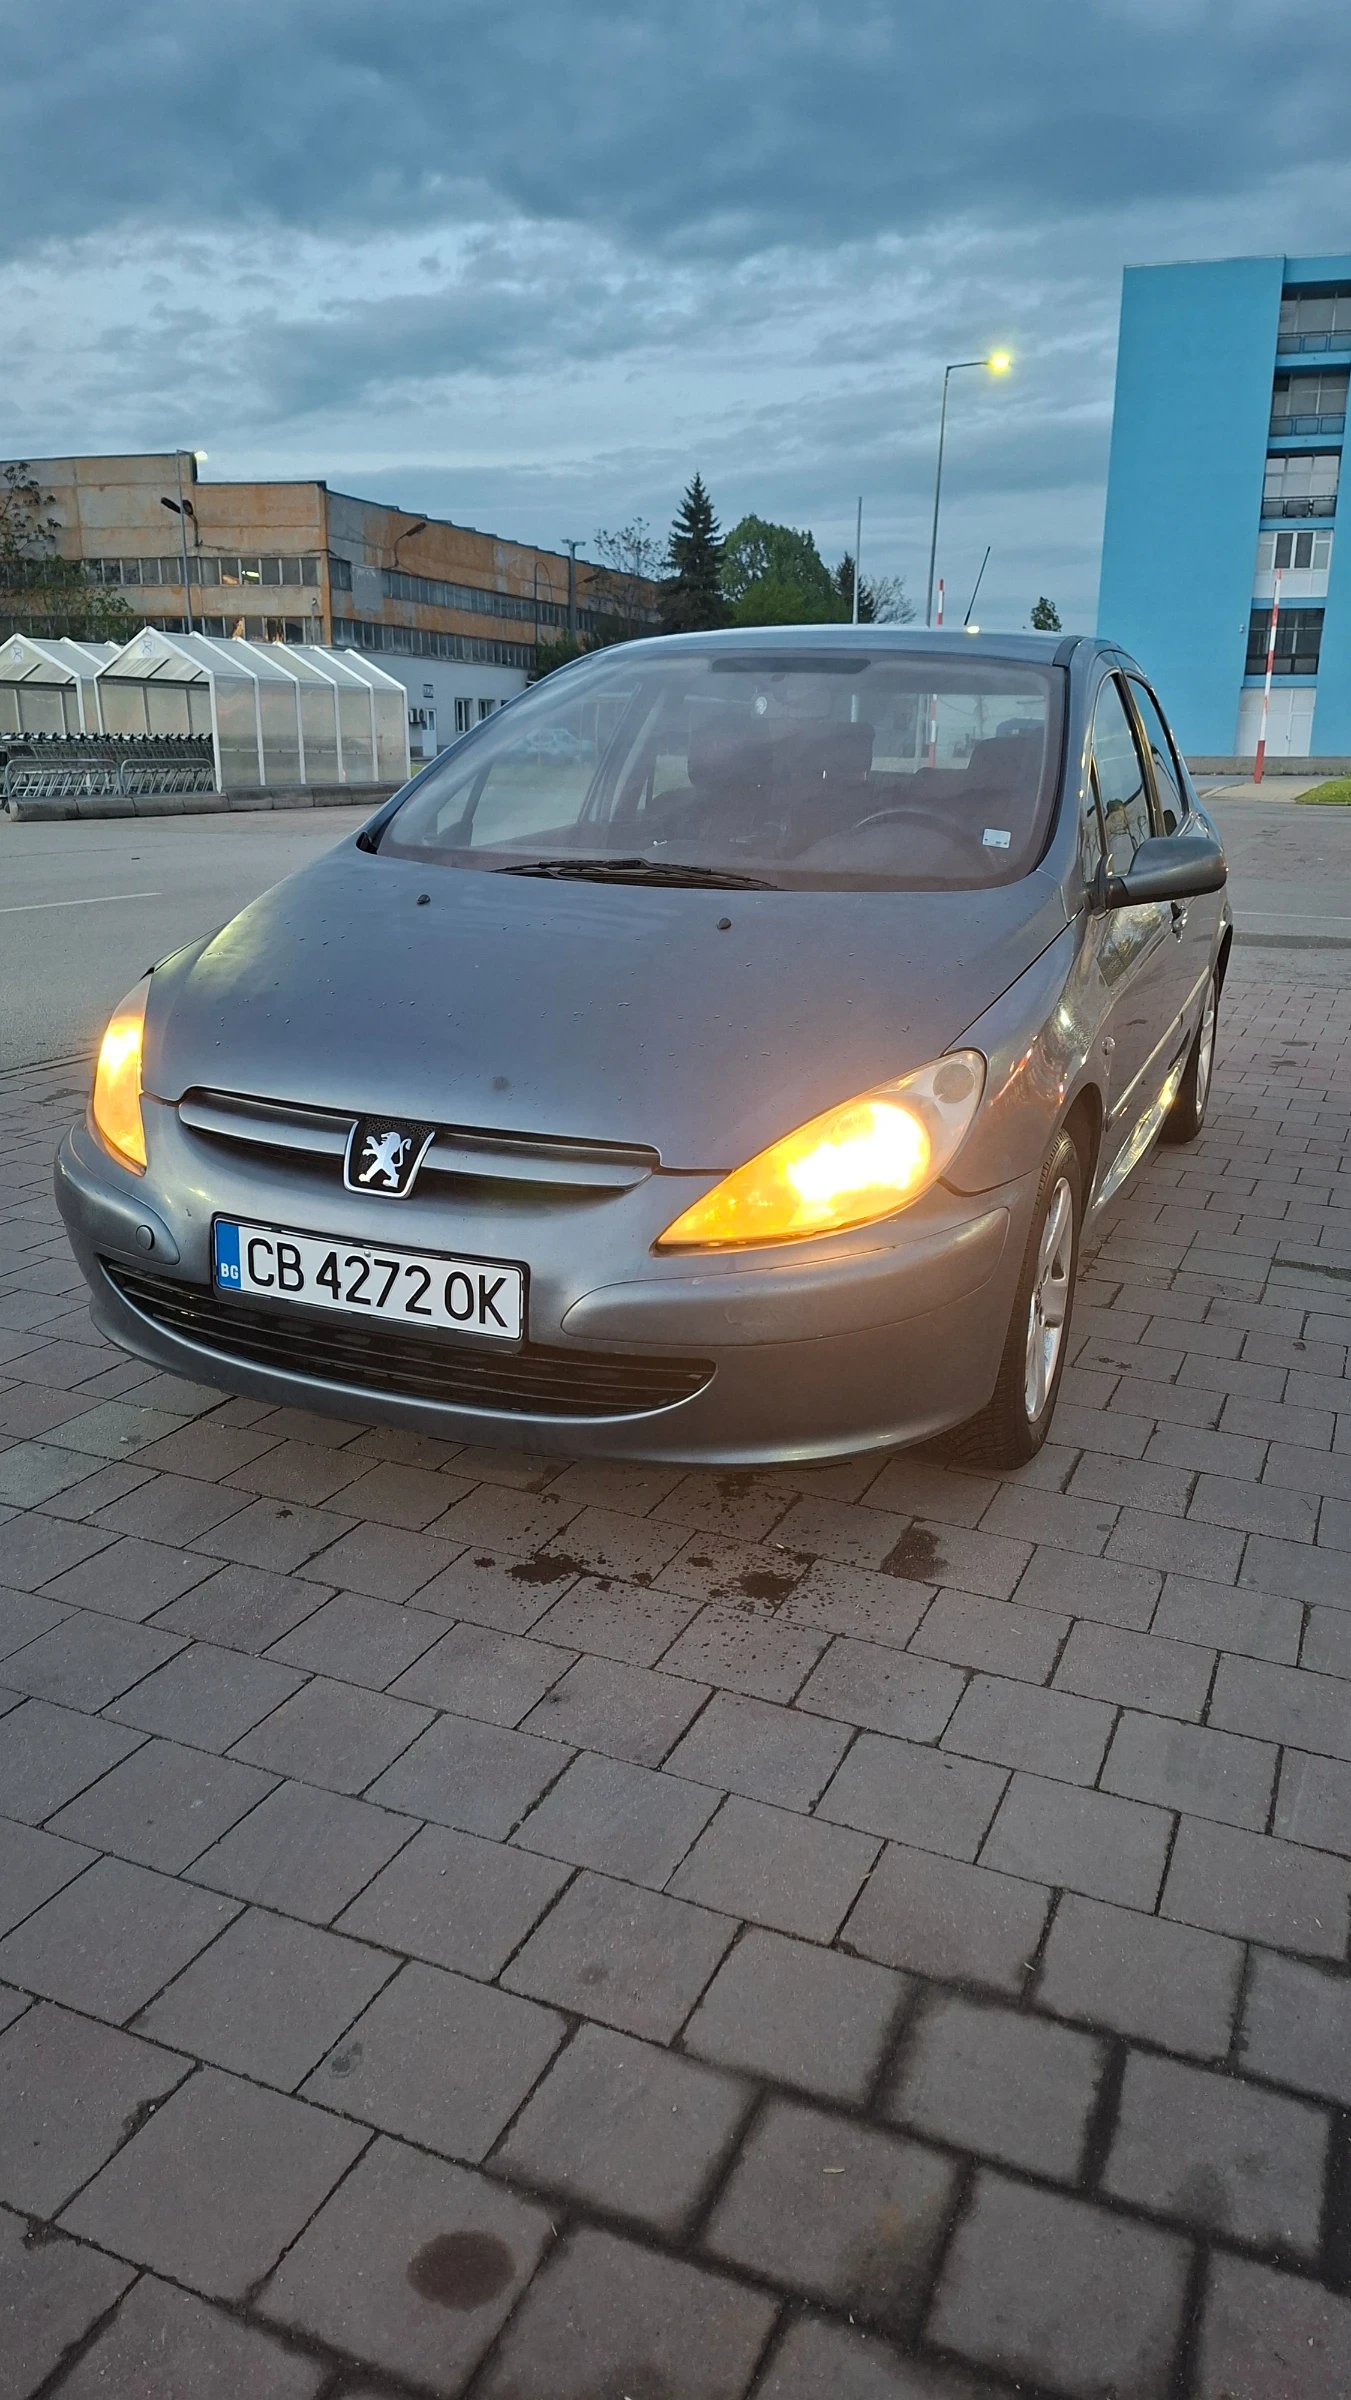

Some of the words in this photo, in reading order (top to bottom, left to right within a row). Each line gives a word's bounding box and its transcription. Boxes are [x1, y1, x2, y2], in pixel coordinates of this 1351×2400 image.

[220, 1262, 239, 1279] BG
[247, 1237, 305, 1292] CB
[315, 1251, 432, 1316] 4272
[444, 1271, 508, 1328] OK
